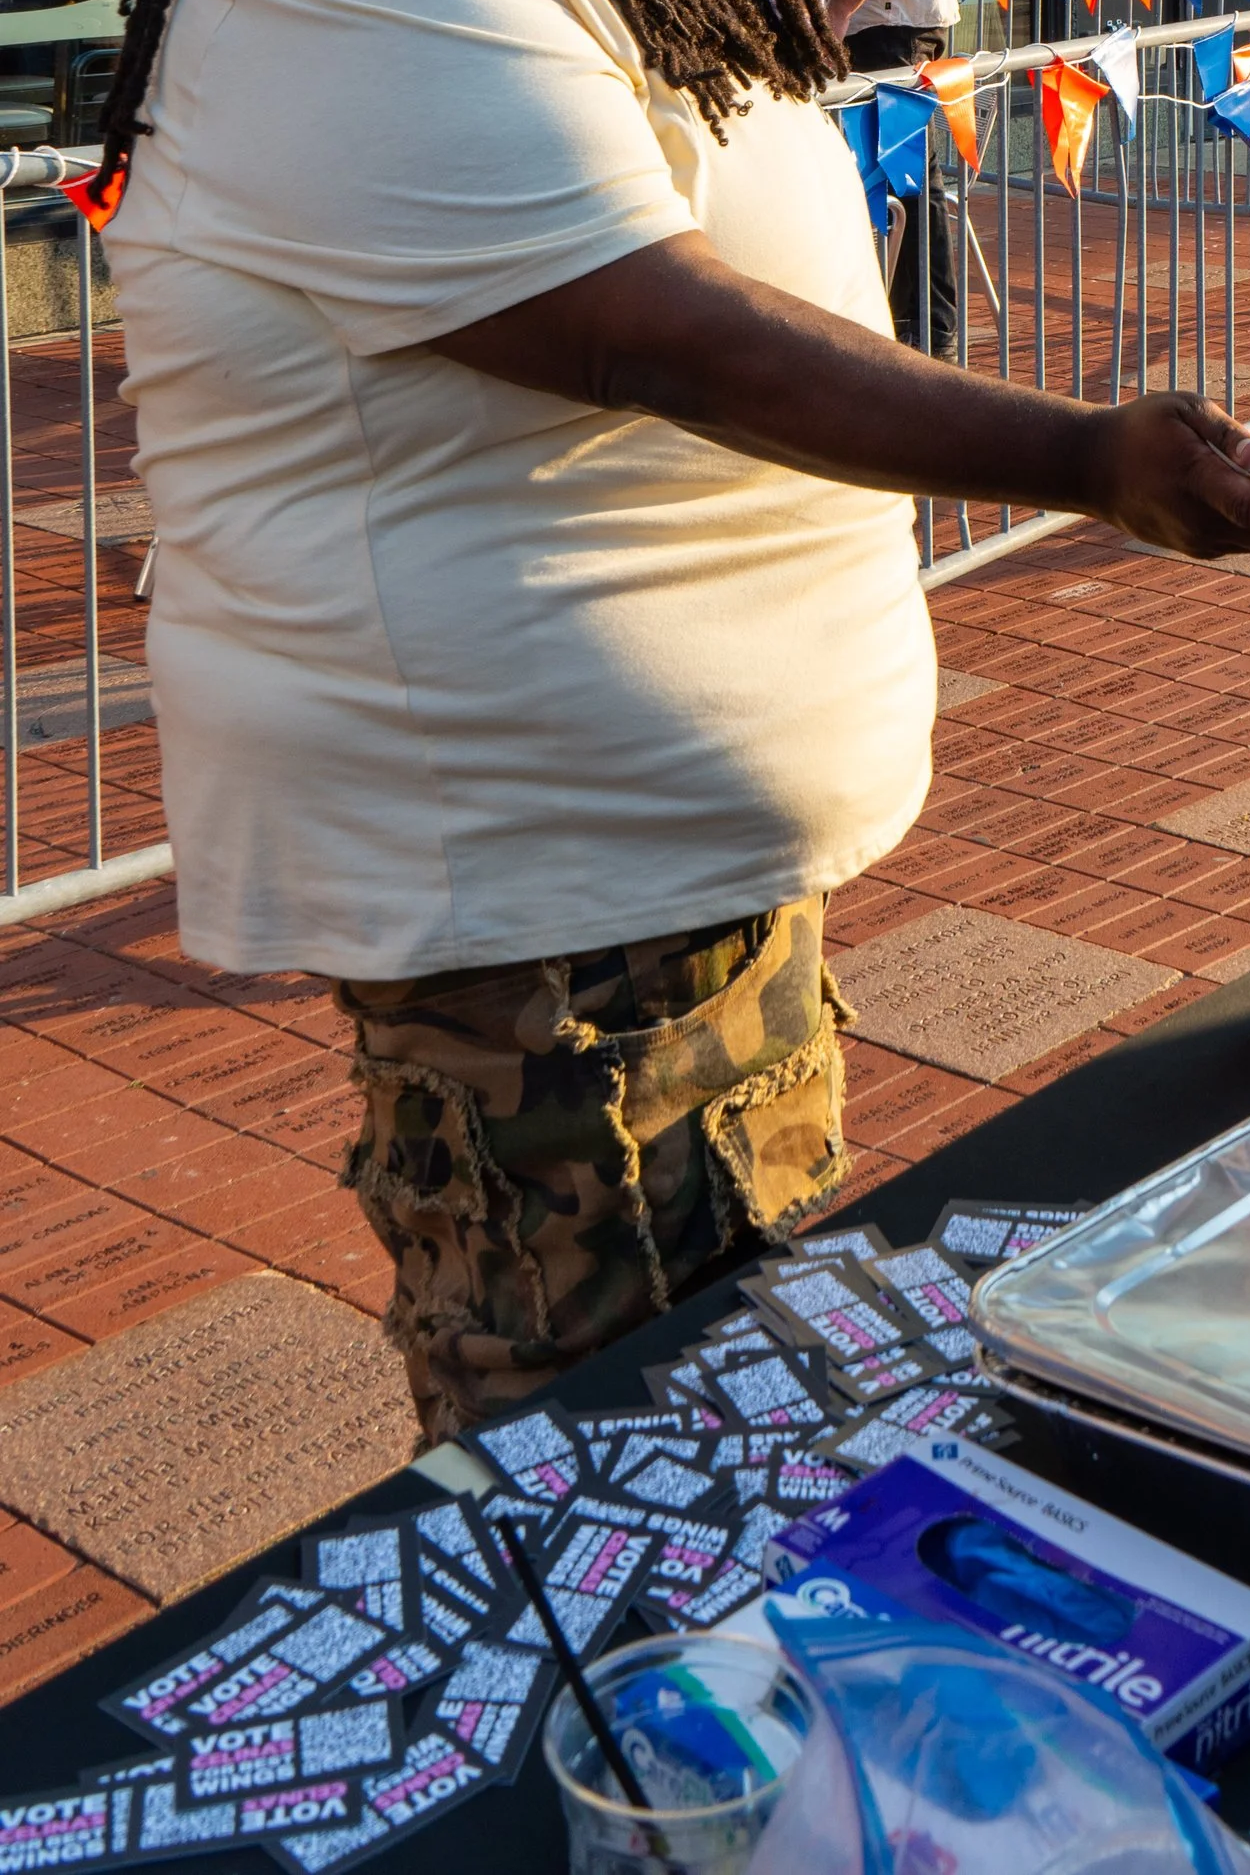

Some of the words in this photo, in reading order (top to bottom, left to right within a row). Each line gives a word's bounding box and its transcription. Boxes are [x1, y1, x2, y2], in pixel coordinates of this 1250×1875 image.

[900, 919, 976, 959] MEMORY
[851, 983, 904, 1013] DAVID
[910, 958, 961, 983] ROSS
[964, 934, 1009, 961] ELLIS
[888, 986, 938, 1014] APRIL
[908, 993, 988, 1035] OCTOBER
[966, 973, 1057, 1023] AUSTRALIA
[970, 1008, 1053, 1057] JENNIFER
[108, 1266, 216, 1319] CAMPAGNA
[119, 1270, 181, 1301] JAMES
[904, 1286, 947, 1329] VOTE
[808, 1313, 861, 1359] VOTE
[827, 1309, 877, 1350] CELINAS
[0, 1387, 83, 1434] amuel
[125, 1293, 274, 1370] Westerman
[73, 1337, 229, 1419] Foundation
[135, 1371, 271, 1442] President
[62, 1453, 146, 1499] Keith
[196, 1393, 262, 1432] Muir
[65, 1406, 149, 1458] James
[66, 1459, 176, 1522] Martha
[230, 1397, 296, 1435] Muir
[780, 1463, 848, 1479] CELIN
[783, 1448, 828, 1468] VO
[83, 1488, 161, 1533] Kent
[156, 1486, 278, 1560] DETROIT
[311, 1435, 375, 1474] SAM
[779, 1483, 845, 1500] WIN
[119, 1518, 174, 1558] FOR
[185, 1485, 242, 1521] THE
[647, 1511, 729, 1544] WINGS
[815, 1506, 851, 1533] M
[577, 1529, 630, 1595] CELINAS
[597, 1535, 653, 1600] VOTE
[121, 1650, 221, 1710] VOTE
[187, 1652, 281, 1715] VOTE
[208, 1663, 291, 1725] CELINAS
[189, 1719, 295, 1756] VOTE
[189, 1739, 295, 1771] CELINAS
[190, 1762, 235, 1779] FOR
[239, 1752, 295, 1772] BEST
[191, 1766, 296, 1799] WINGS
[373, 1751, 466, 1811] CELINAS
[0, 1792, 108, 1830] VOTE
[240, 1795, 348, 1834] VOTE
[241, 1780, 348, 1815] CELINAS
[381, 1762, 483, 1827] VOTE
